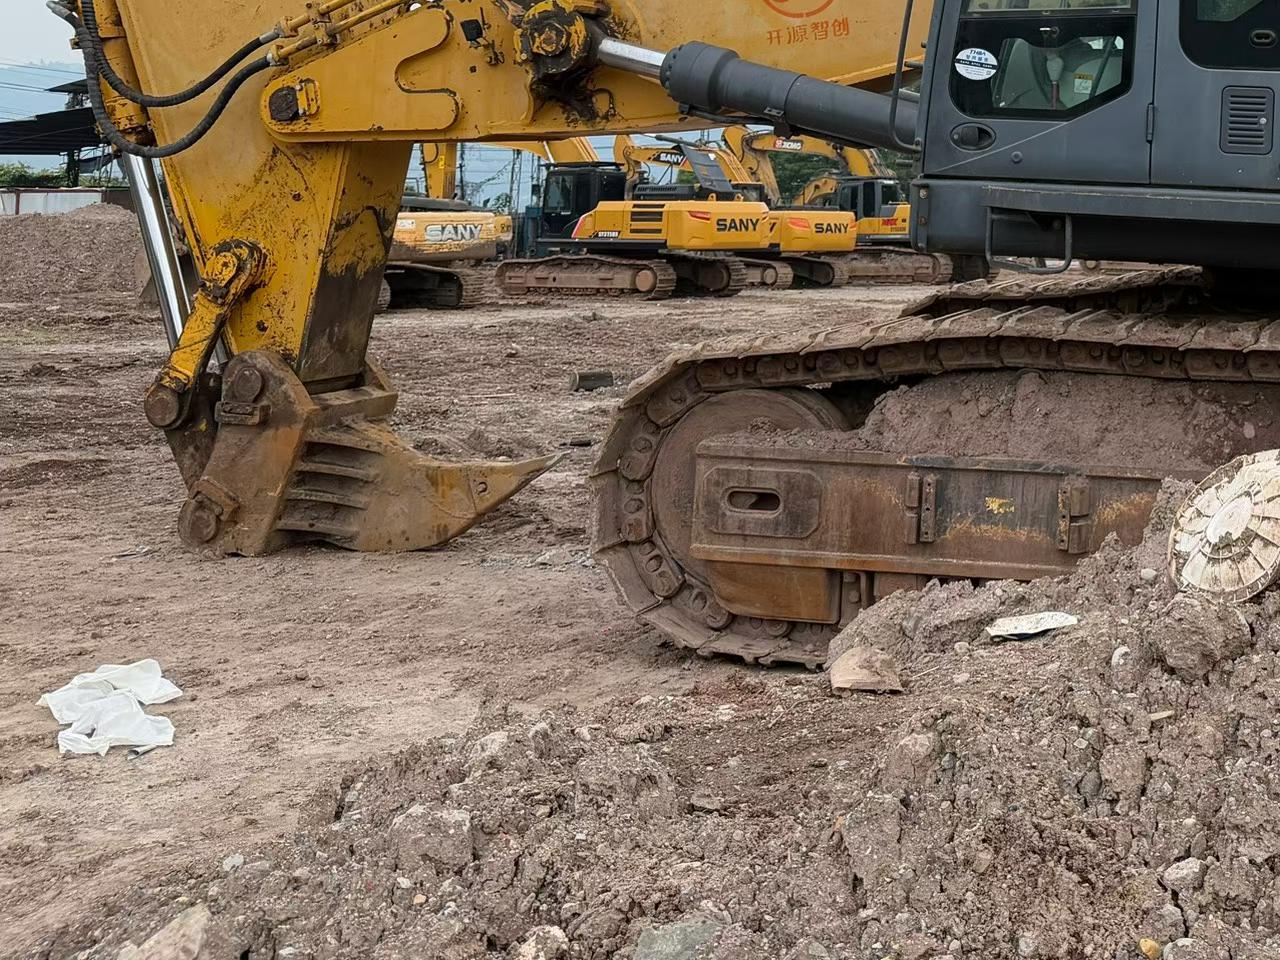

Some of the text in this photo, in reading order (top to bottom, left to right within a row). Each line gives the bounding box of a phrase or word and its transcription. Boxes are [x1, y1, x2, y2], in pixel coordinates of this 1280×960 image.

[767, 17, 850, 45] 开源智创
[659, 153, 683, 164] SANY
[716, 218, 760, 232] SANY
[814, 222, 849, 234] SANY
[425, 223, 483, 242] SANY
